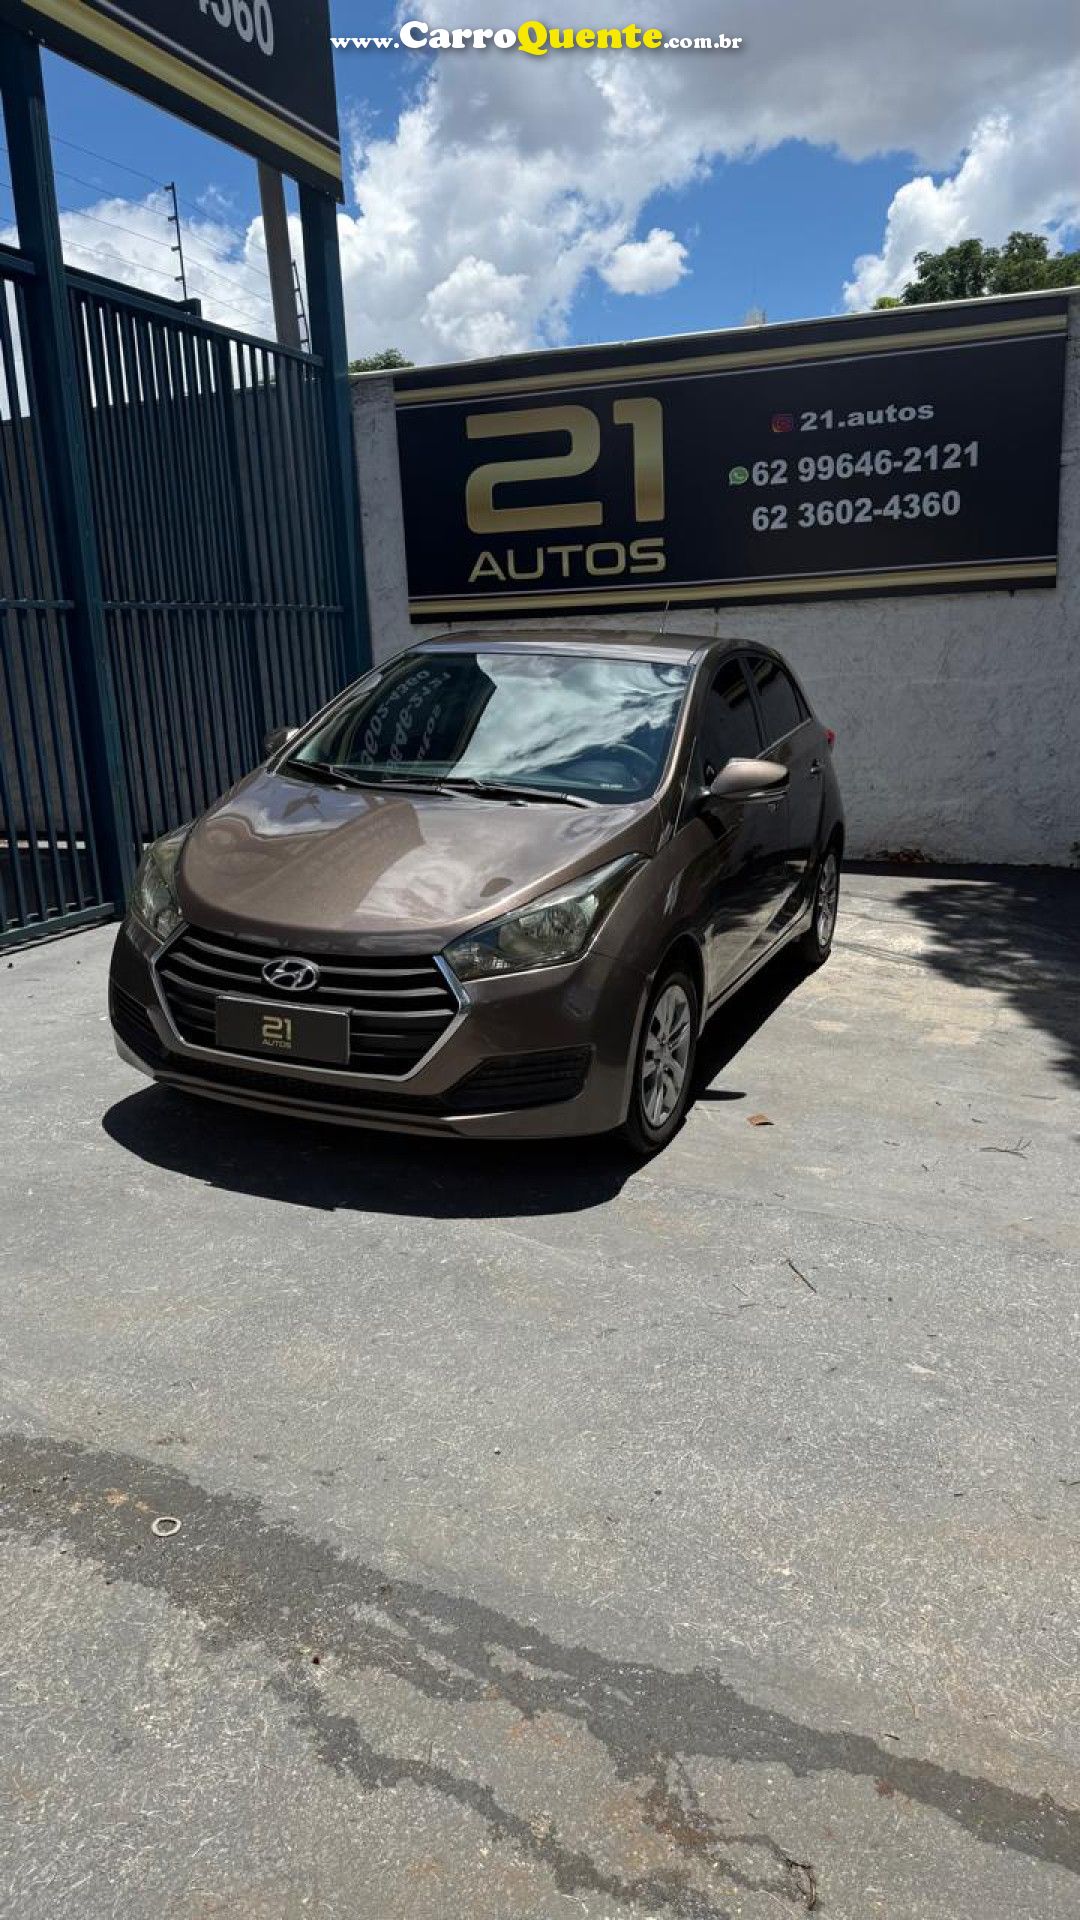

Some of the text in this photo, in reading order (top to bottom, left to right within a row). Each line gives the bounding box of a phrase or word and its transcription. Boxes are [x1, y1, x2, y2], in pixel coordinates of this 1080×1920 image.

[200, 0, 274, 56] 60
[800, 404, 935, 432] 21.autos
[465, 397, 665, 535] 21
[752, 441, 980, 487] 62 99646-2121
[752, 490, 961, 531] 62 3602-4360
[468, 537, 667, 583] AUTOS
[262, 1016, 292, 1040] 21
